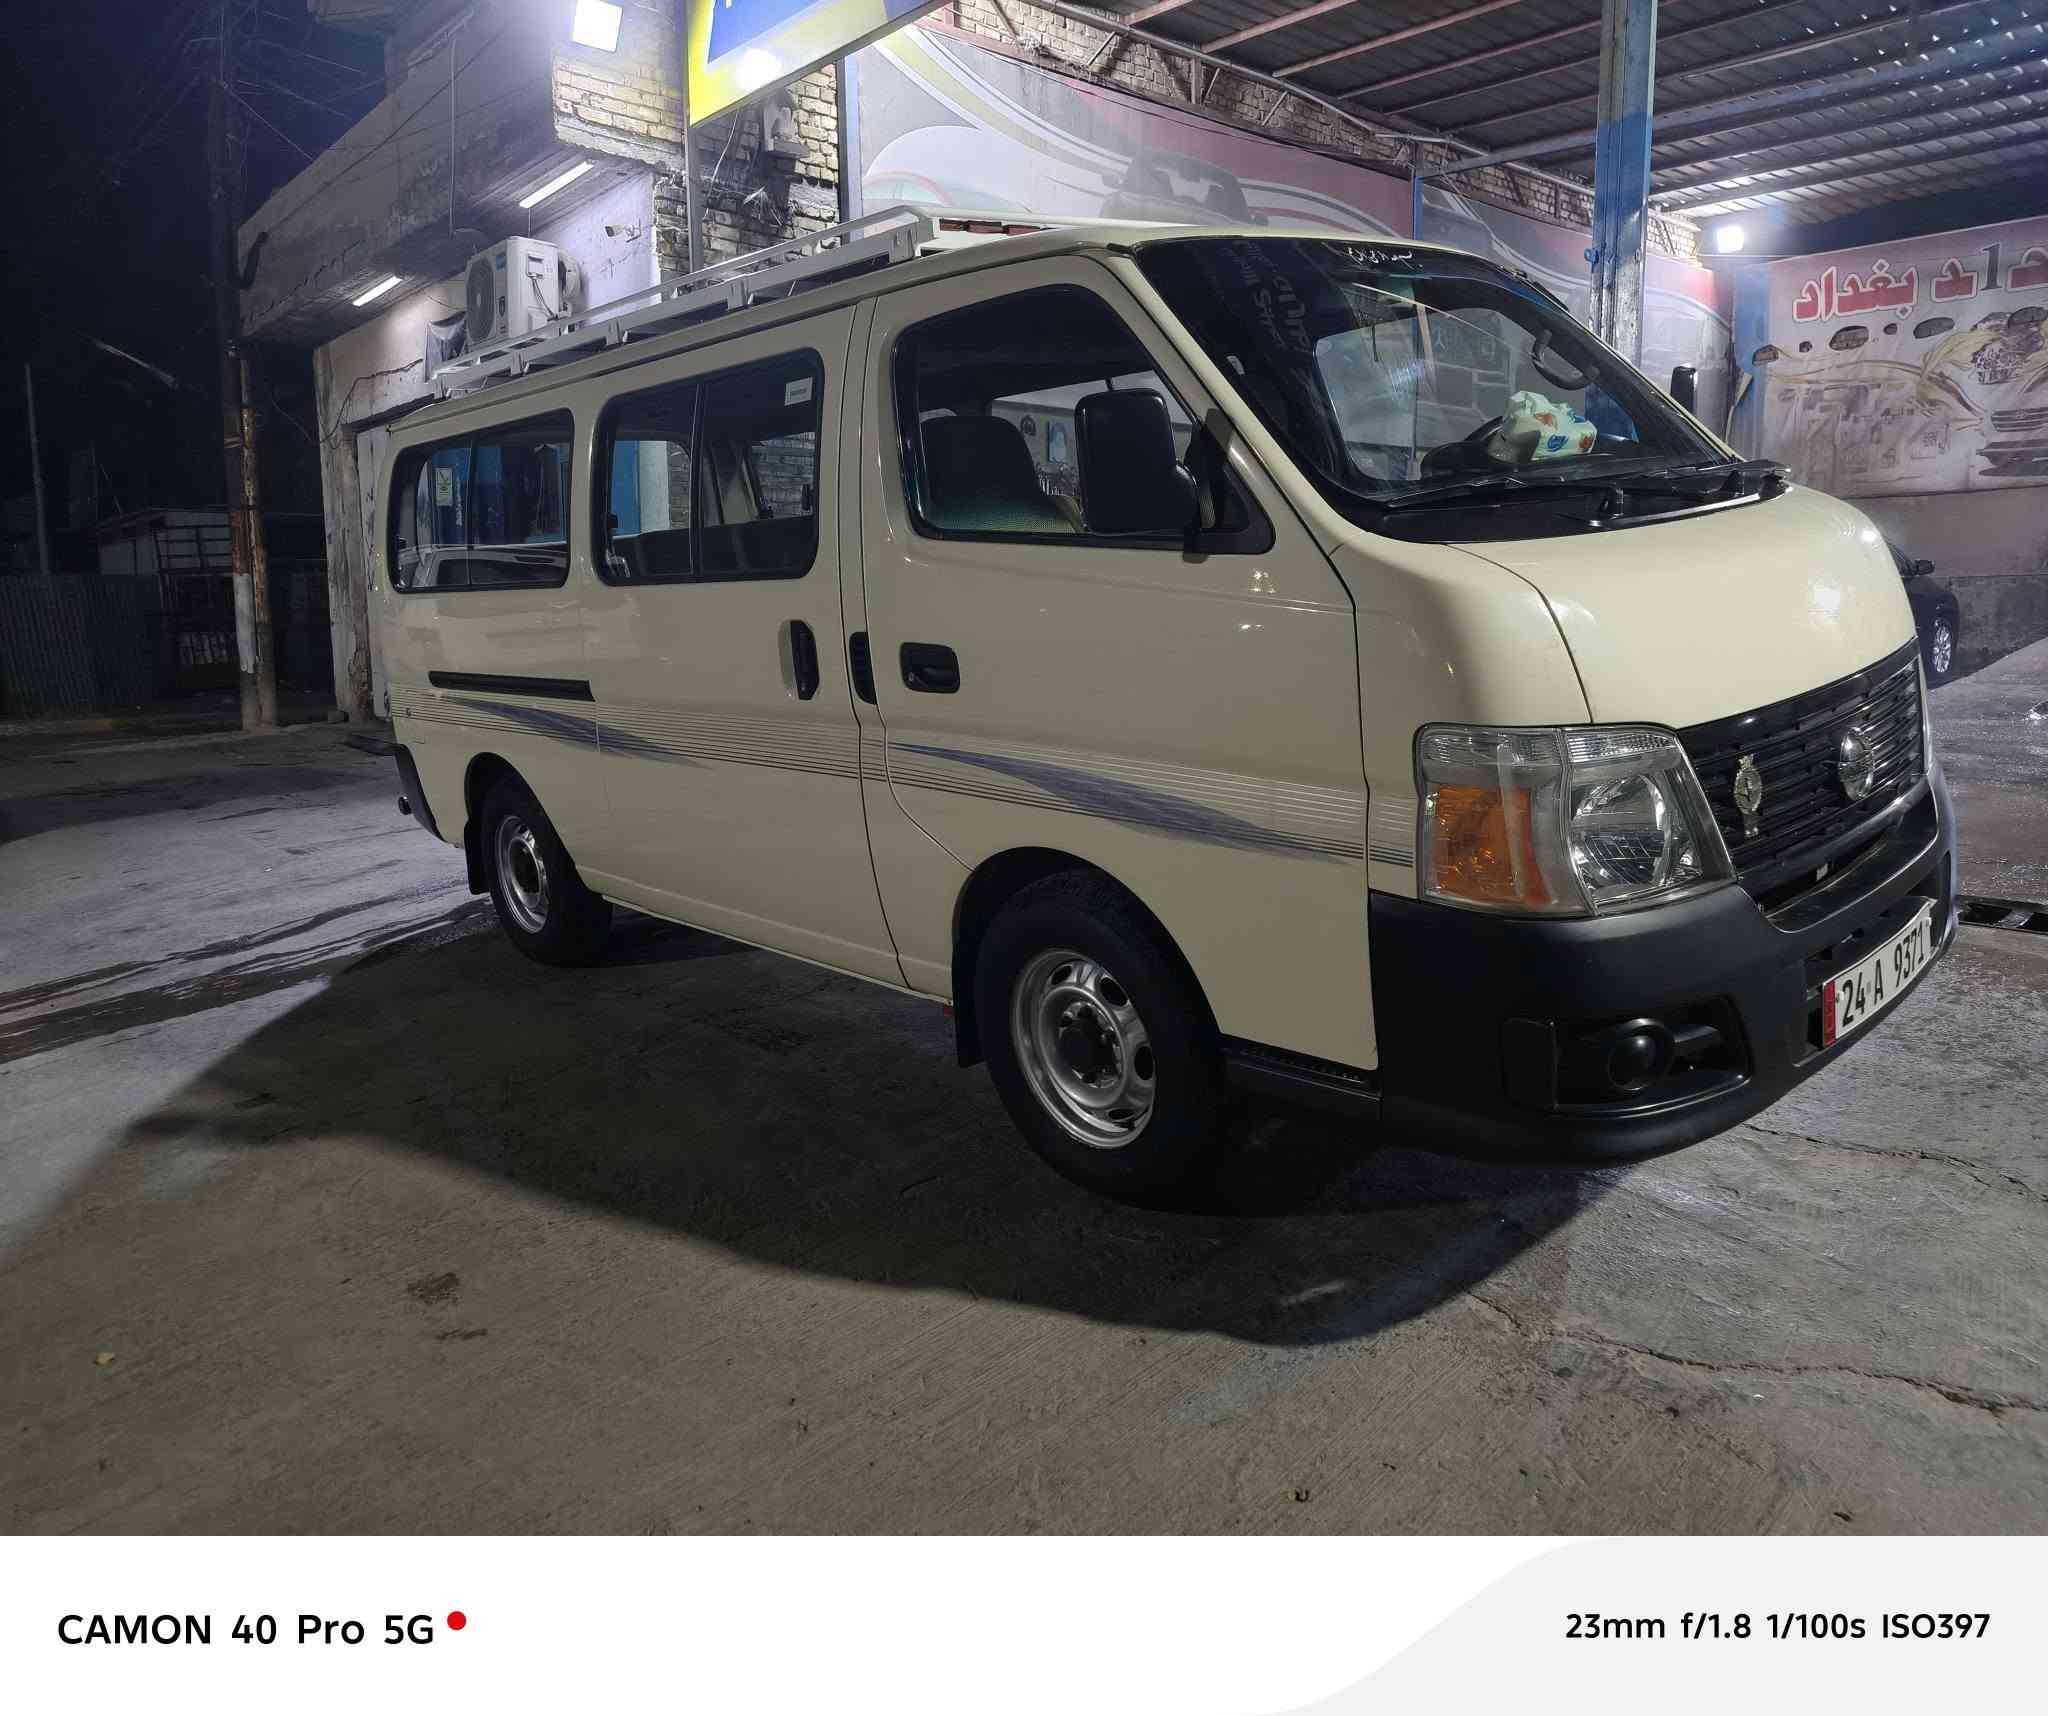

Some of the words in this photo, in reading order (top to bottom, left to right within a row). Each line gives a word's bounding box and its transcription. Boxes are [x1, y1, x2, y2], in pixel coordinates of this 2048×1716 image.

[1792, 258, 1919, 322] بغداد
[1841, 971, 1867, 1027] 24
[1873, 958, 1884, 1005] A
[1894, 919, 1925, 988] 9371
